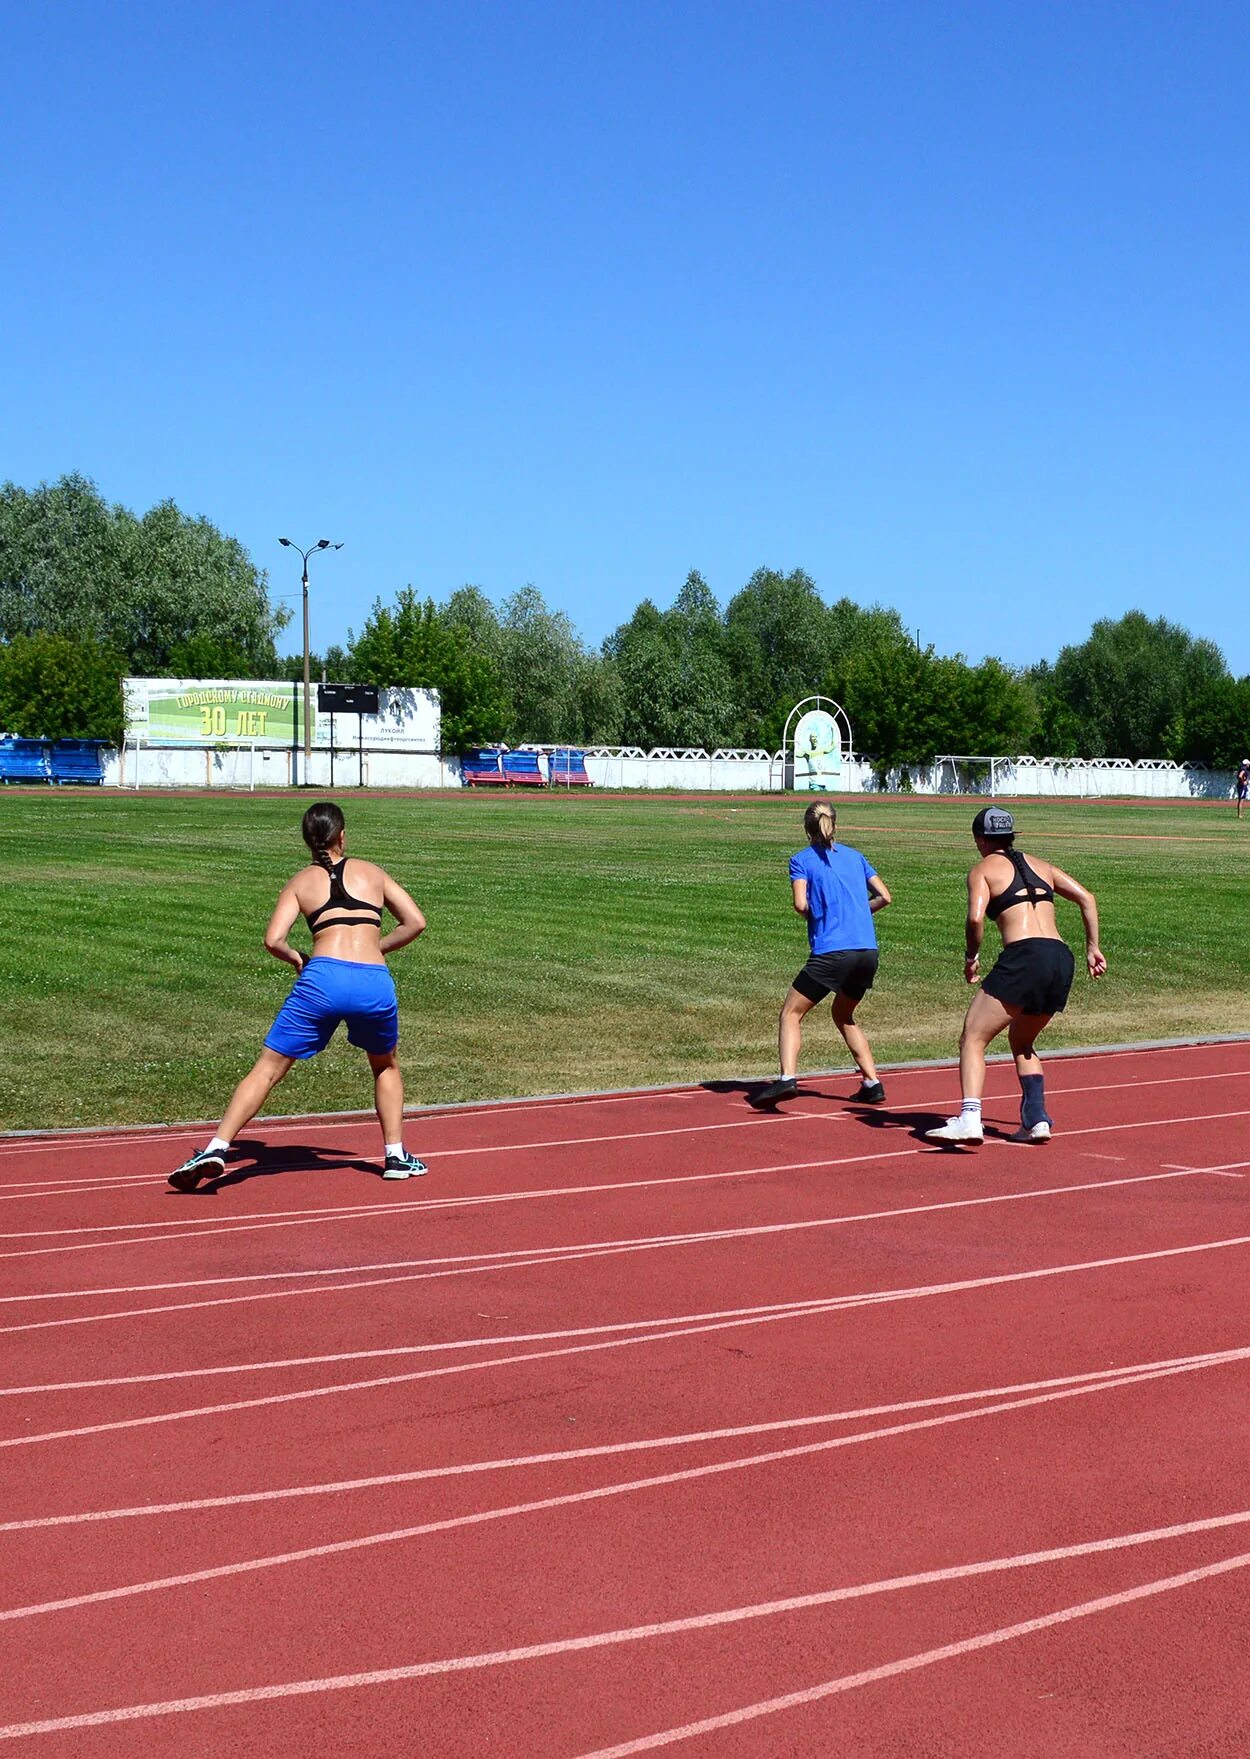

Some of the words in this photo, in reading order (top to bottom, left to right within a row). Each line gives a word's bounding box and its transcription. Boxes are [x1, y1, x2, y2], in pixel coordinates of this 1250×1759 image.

[176, 688, 238, 709] ГОРОДСКОМУ
[239, 690, 290, 711] СТАДИОНУ
[200, 705, 226, 736] 30
[237, 711, 268, 736] ЛЕТ
